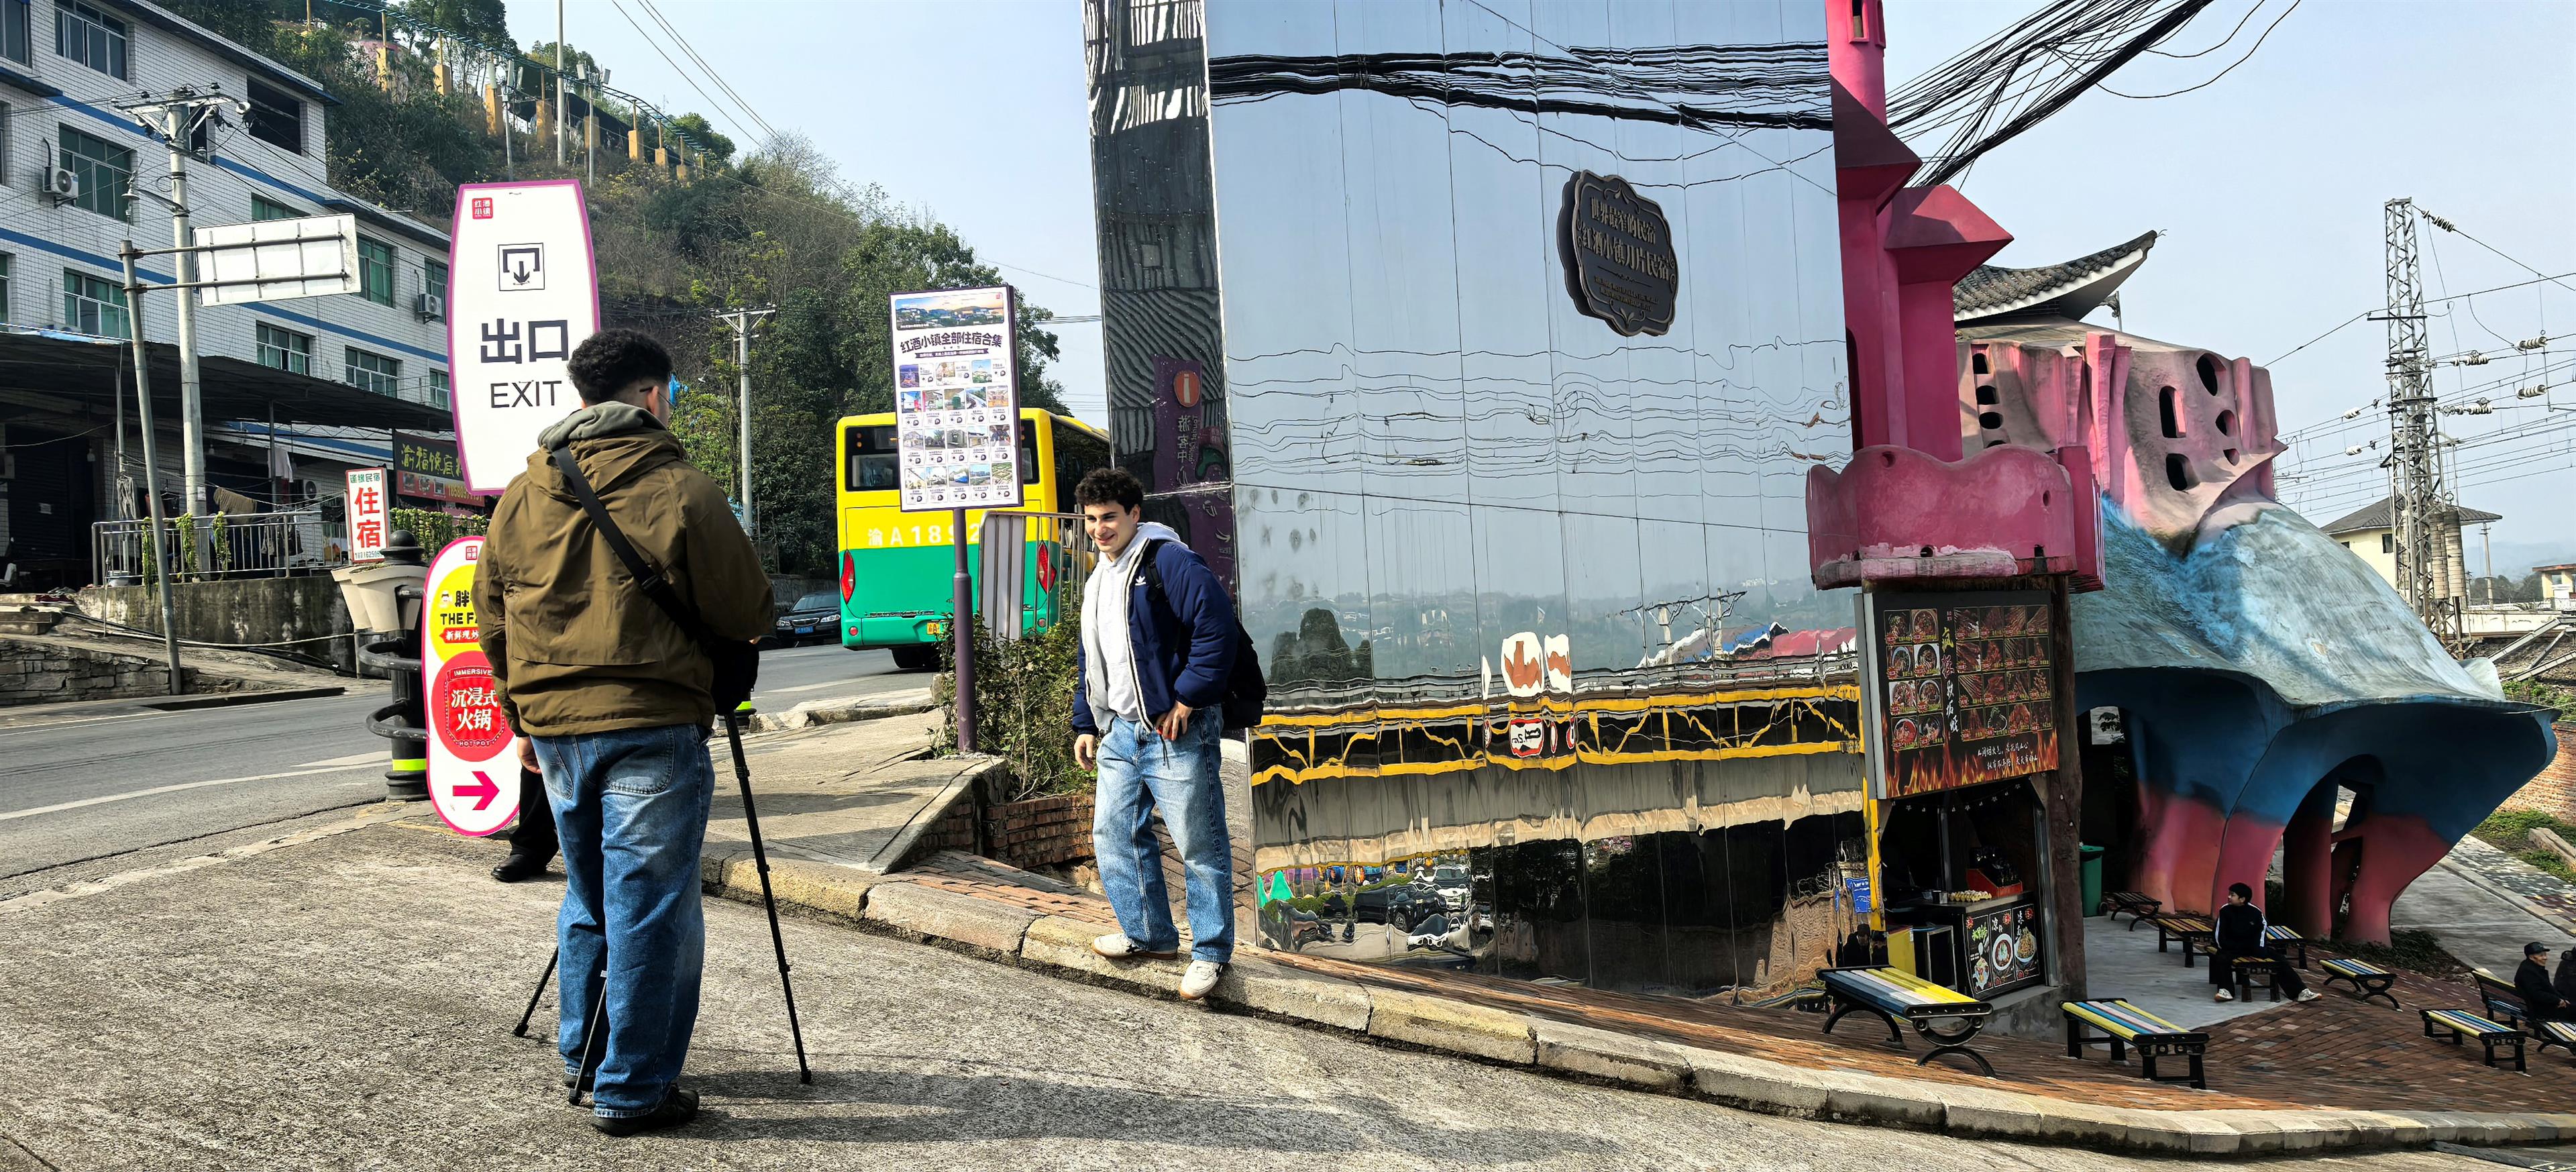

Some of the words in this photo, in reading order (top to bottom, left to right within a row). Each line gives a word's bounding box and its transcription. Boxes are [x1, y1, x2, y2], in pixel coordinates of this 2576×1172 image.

[1591, 197, 1656, 244] 世界最窄的民宿
[1581, 223, 1670, 280] 红酒小镇刀片民宿
[480, 318, 569, 364] 出口
[900, 331, 1003, 354] 红酒小镇全部住宿合集
[490, 380, 562, 408] EXIT
[355, 487, 381, 548] 住宿
[440, 613, 464, 625] THE
[451, 686, 498, 708] 沉浸式
[455, 708, 492, 731] 火锅
